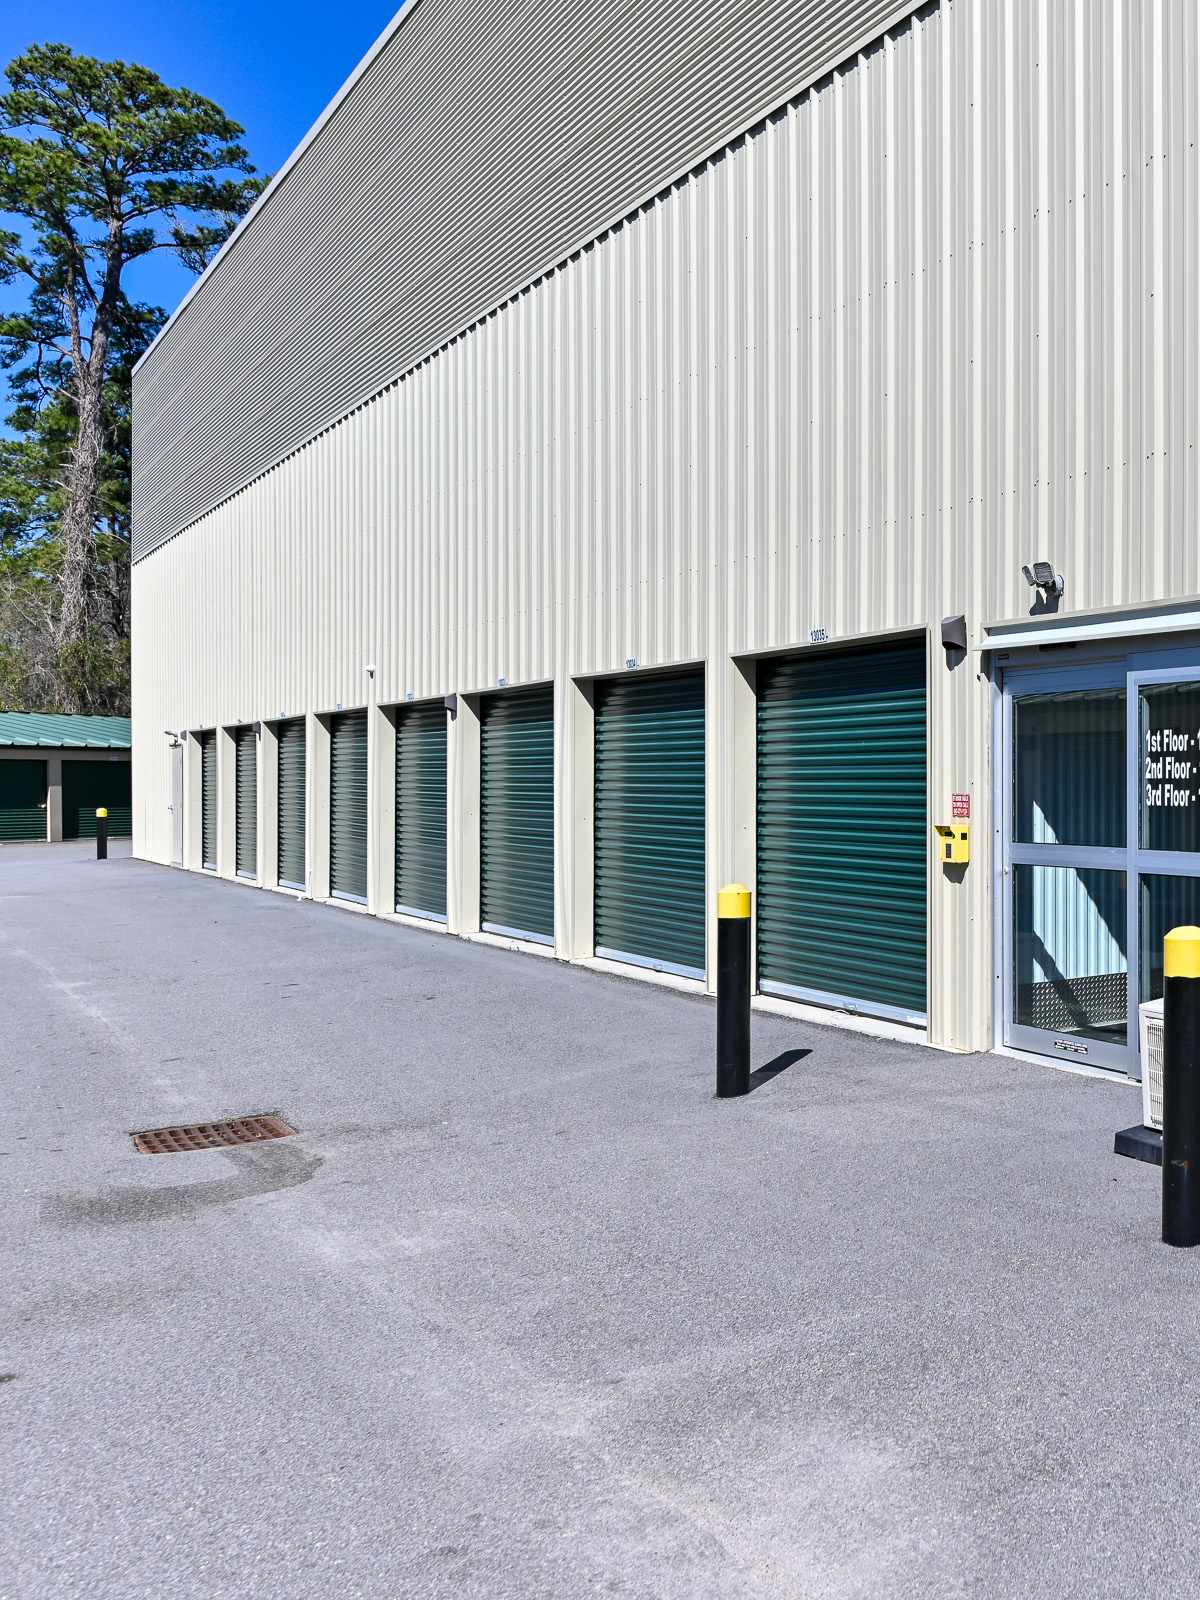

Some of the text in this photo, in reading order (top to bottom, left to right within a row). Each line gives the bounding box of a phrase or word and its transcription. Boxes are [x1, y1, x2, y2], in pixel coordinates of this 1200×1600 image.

[1145, 729, 1161, 752] 1st
[1163, 729, 1189, 752] Floor
[1145, 756, 1163, 779] 2nd
[1165, 756, 1191, 779] Floor
[1145, 783, 1162, 806] 3rd
[1164, 784, 1190, 807] Floor
